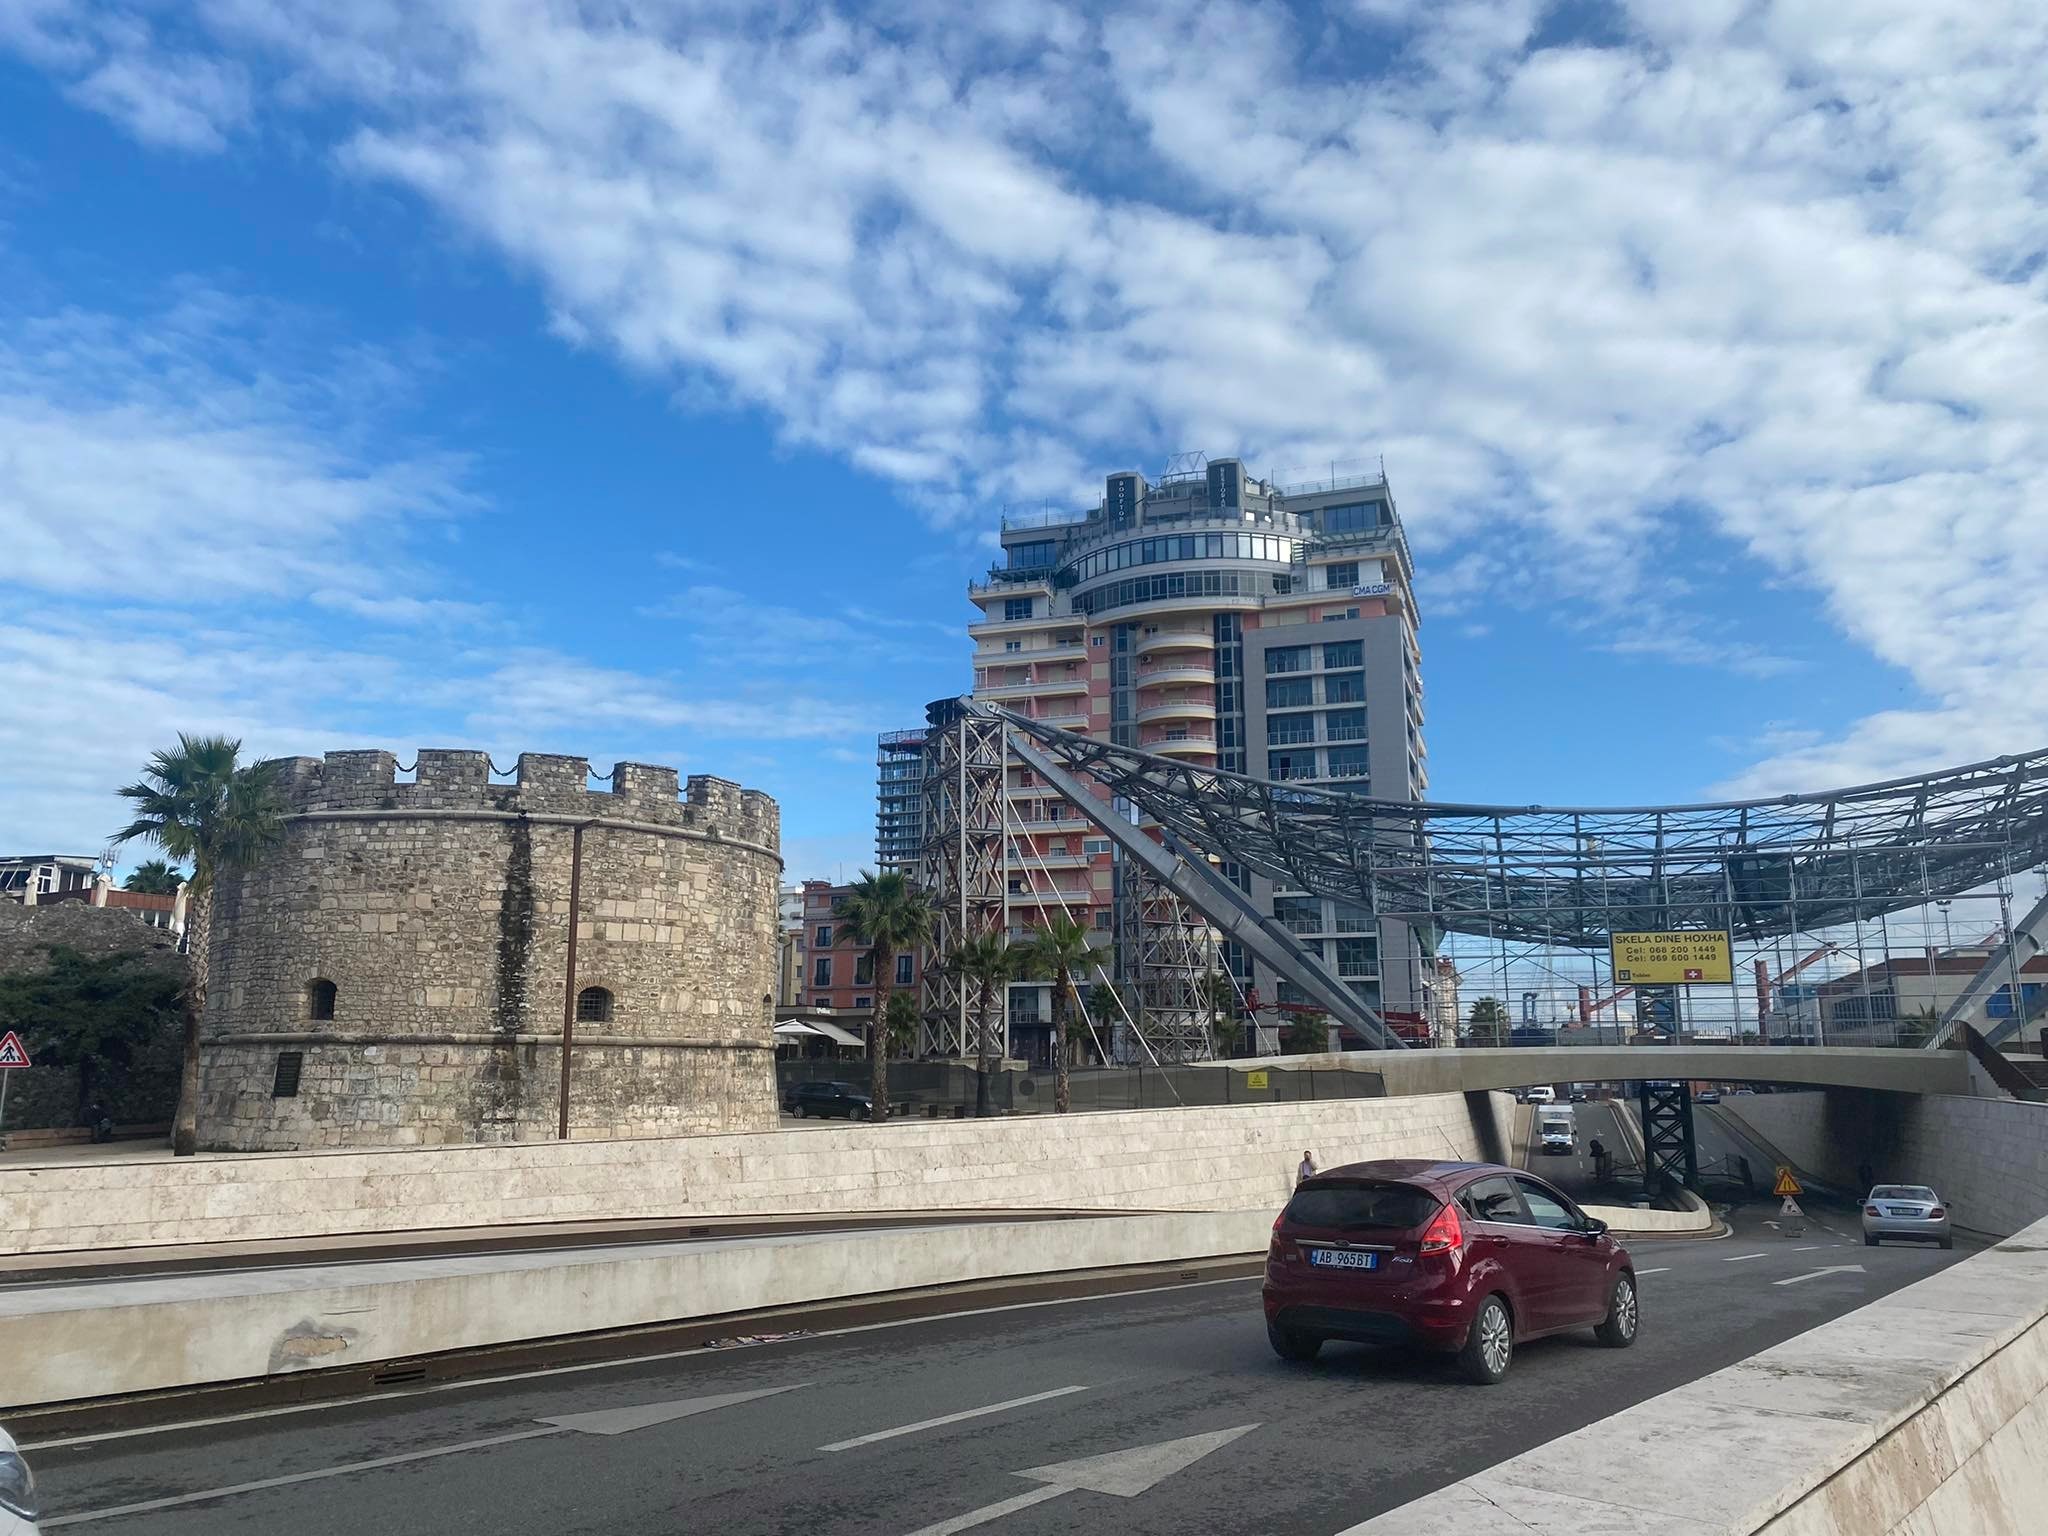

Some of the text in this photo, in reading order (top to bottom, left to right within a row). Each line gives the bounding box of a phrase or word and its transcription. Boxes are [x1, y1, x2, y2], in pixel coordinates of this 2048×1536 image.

[1353, 584, 1391, 596] CMA CGM
[1615, 934, 1725, 943] SKELA DINE HOXHA
[1319, 1251, 1370, 1266] AB 965BT
